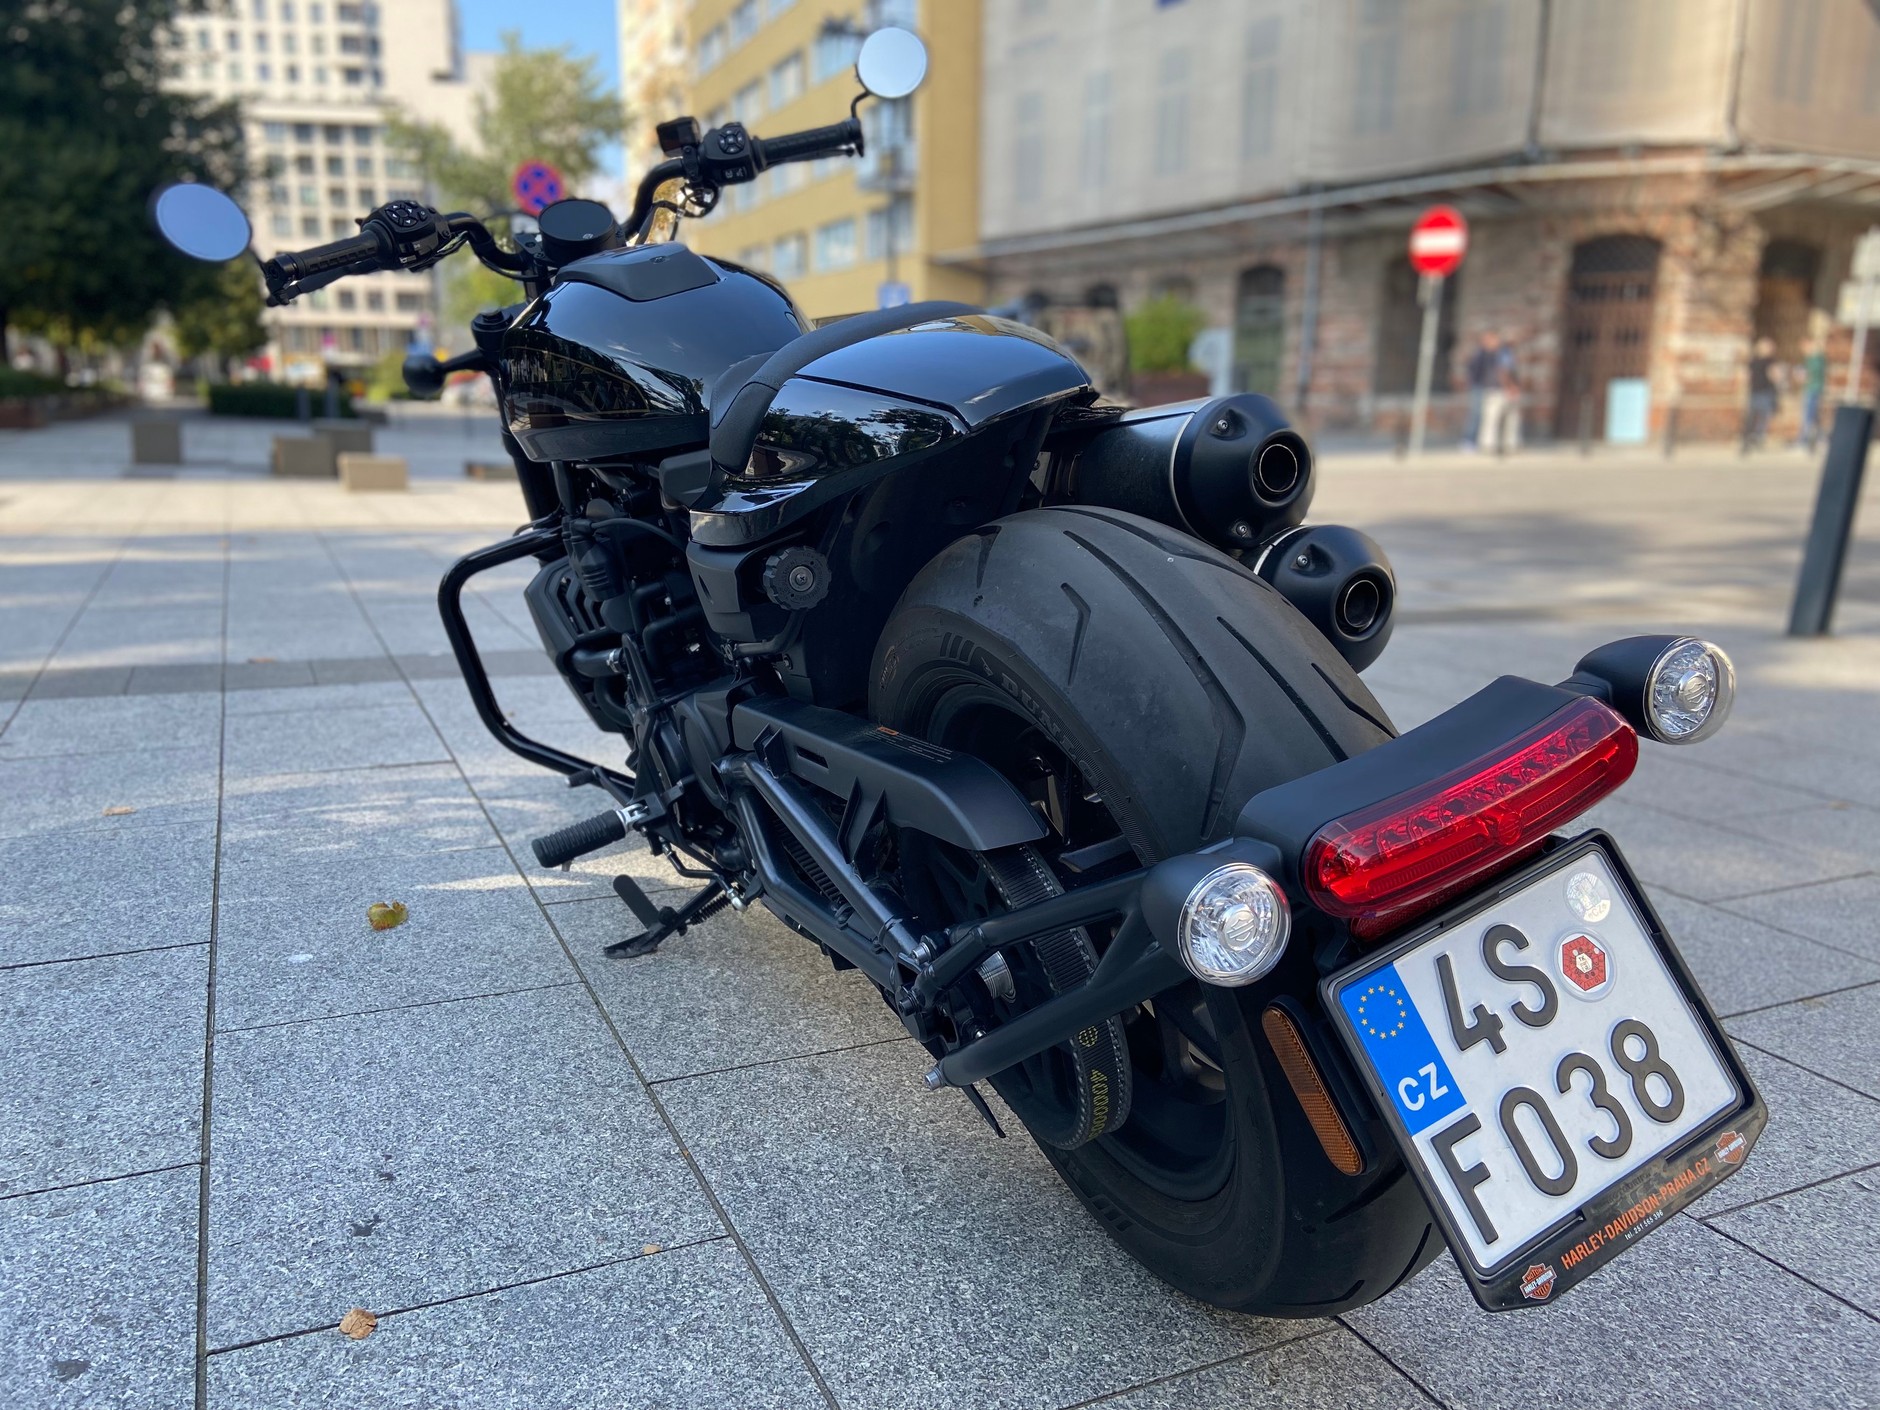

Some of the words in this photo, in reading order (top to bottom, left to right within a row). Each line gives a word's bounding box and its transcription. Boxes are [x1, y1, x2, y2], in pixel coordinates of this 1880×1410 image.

[1435, 923, 1559, 1055] 4S
[1397, 1061, 1449, 1112] CZ
[1430, 1018, 1685, 1246] F038
